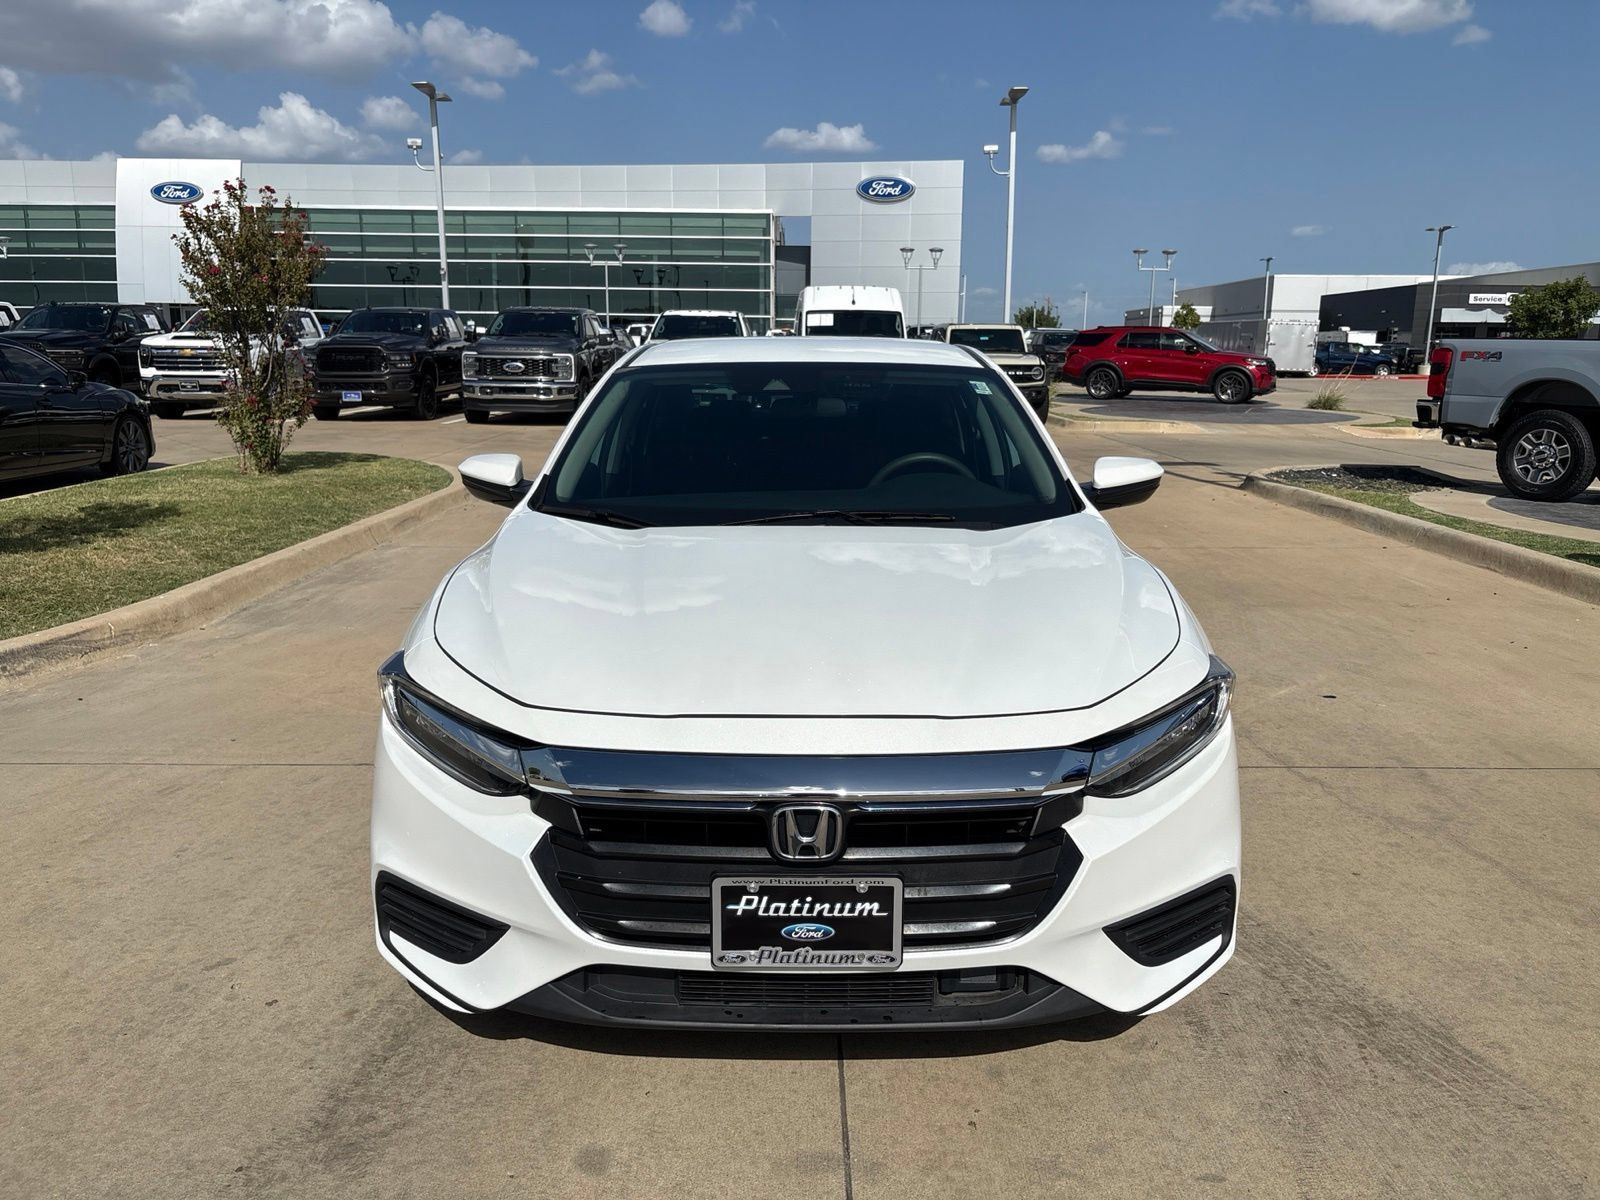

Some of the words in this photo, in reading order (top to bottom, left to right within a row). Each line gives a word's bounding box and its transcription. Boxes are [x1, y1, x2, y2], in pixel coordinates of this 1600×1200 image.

[160, 184, 190, 198] Ford
[868, 180, 903, 196] Ford
[1460, 351, 1503, 361] FX4
[725, 895, 889, 917] Platinum
[791, 925, 825, 939] Ford
[756, 948, 858, 965] Platinum
